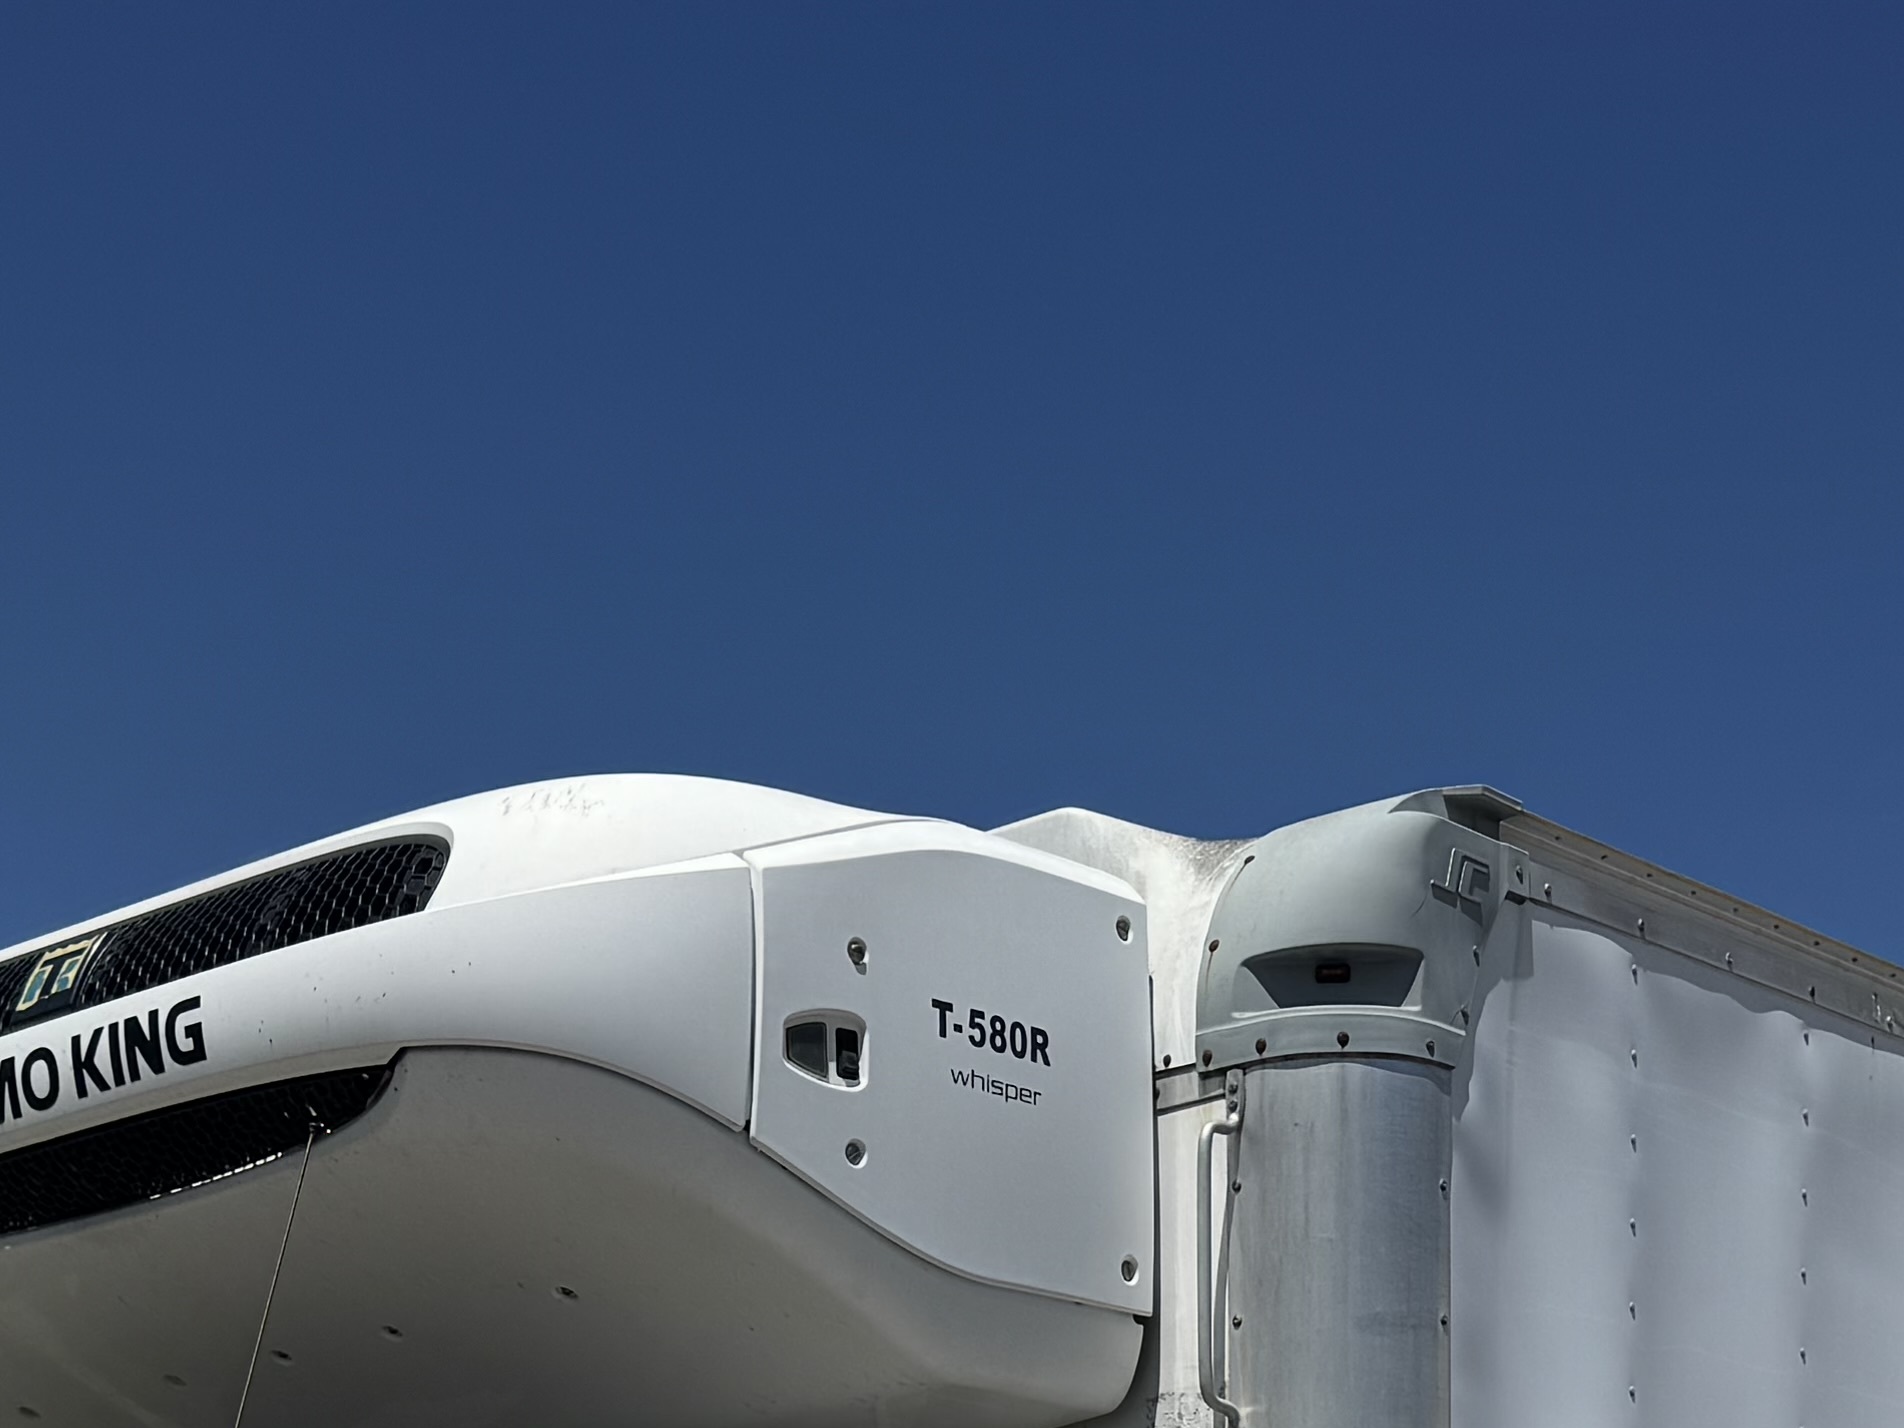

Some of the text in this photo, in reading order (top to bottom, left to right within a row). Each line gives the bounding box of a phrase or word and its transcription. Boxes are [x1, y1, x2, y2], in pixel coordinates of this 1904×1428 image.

[70, 995, 208, 1099] KING
[931, 998, 1051, 1067] T-580R
[950, 1069, 1042, 1105] whisper
